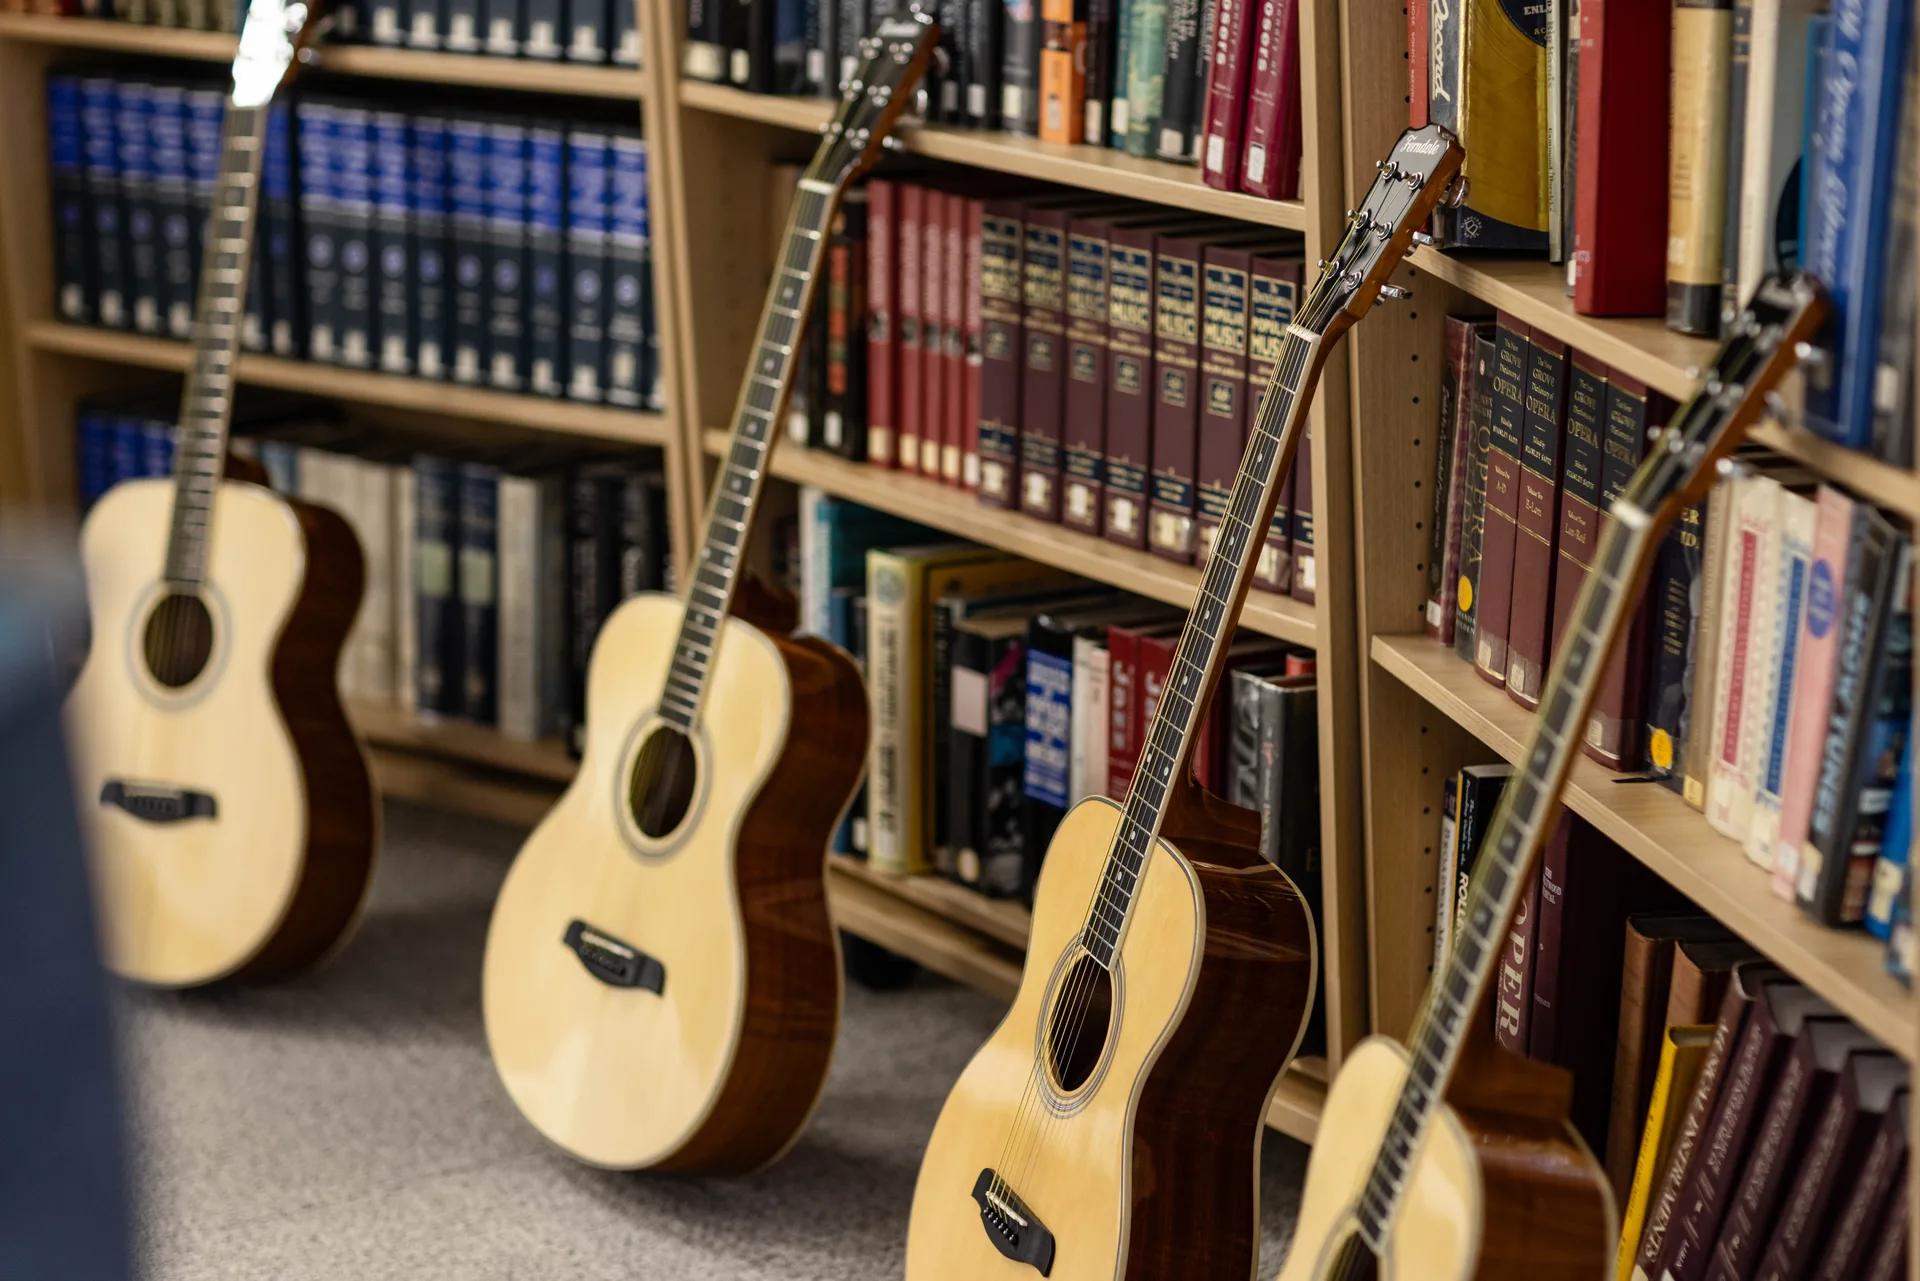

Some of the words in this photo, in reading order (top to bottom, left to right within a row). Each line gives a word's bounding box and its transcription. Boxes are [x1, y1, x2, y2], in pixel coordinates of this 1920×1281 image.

[1400, 134, 1440, 155] Ferndale
[1500, 350, 1521, 368] GROVE
[1493, 376, 1522, 405] OPERA
[1532, 368, 1555, 387] GROVE
[1526, 395, 1556, 425] OPERA
[1574, 390, 1596, 410] GROVE
[1568, 418, 1599, 449] OPERA
[1604, 438, 1637, 469] OPERA
[1469, 425, 1491, 565] OPERA
[1499, 898, 1528, 1049] OPER
[1646, 1114, 1699, 1264] INSTRUMENTS
